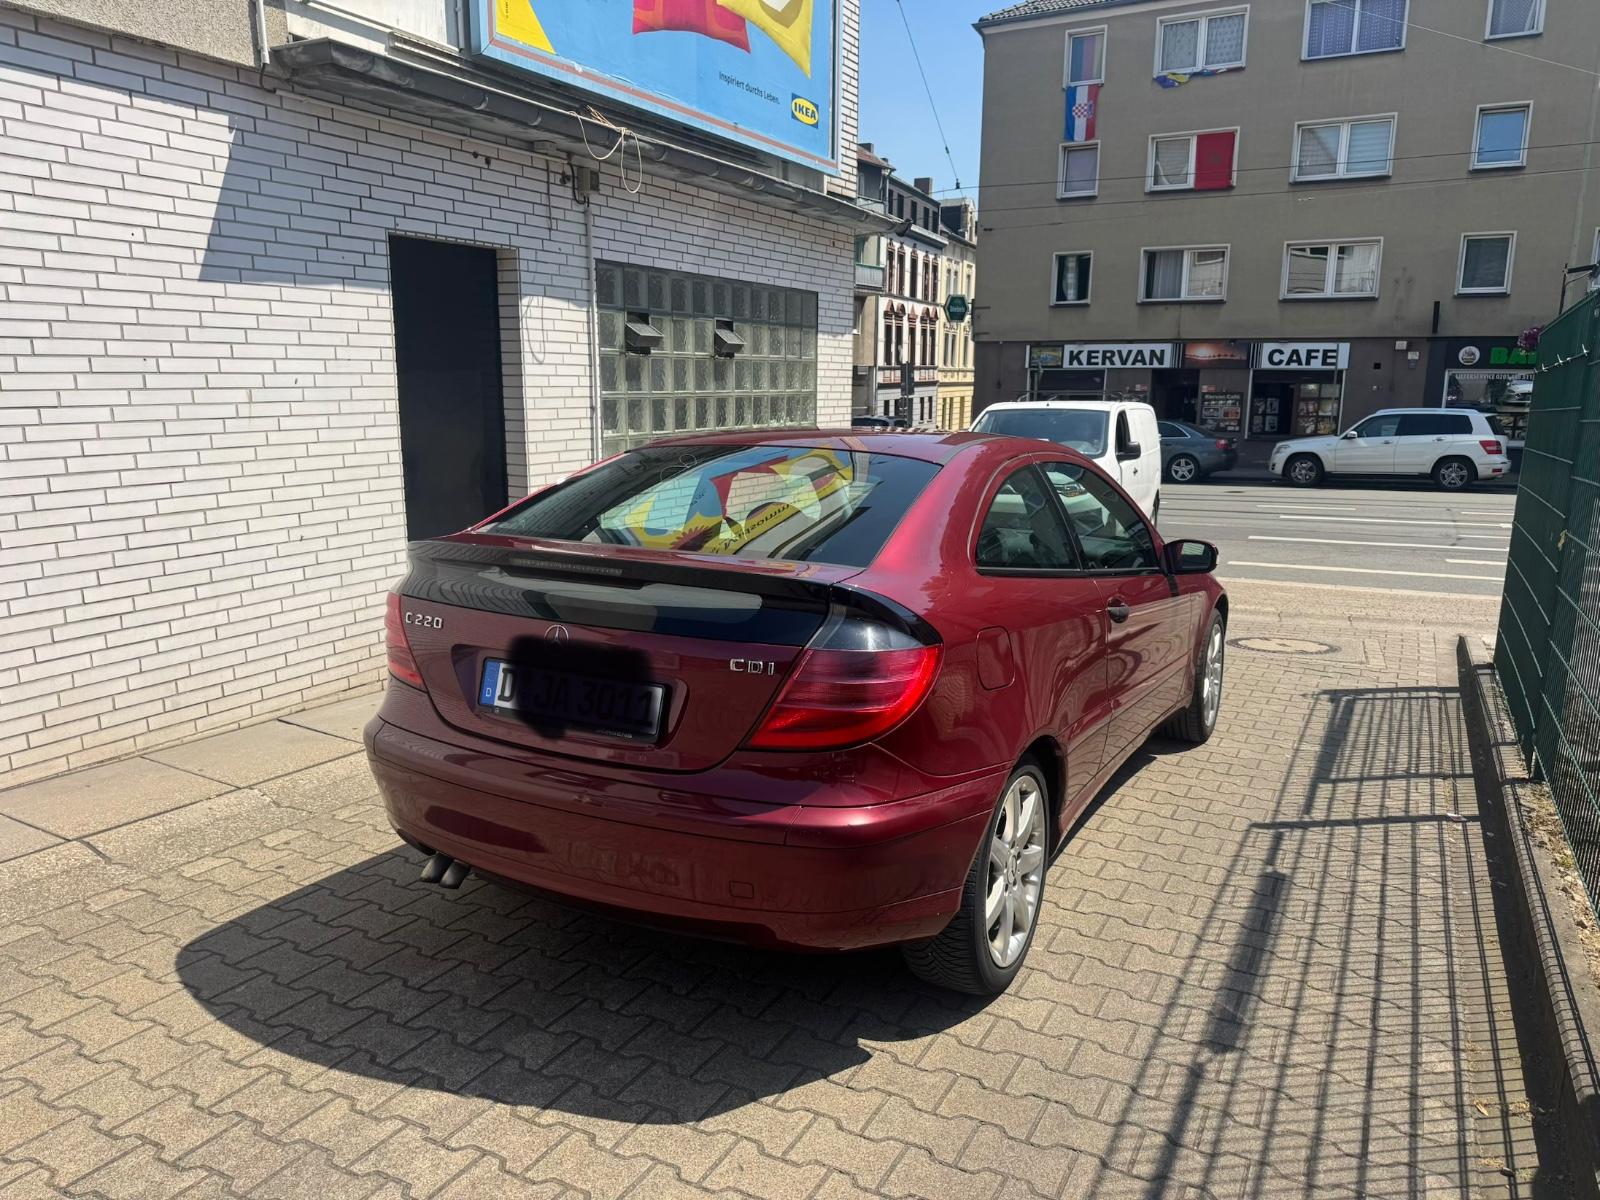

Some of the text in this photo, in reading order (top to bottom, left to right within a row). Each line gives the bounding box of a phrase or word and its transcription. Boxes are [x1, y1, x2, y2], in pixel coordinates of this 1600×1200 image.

[719, 71, 780, 105] Inspiriert durchs Leben.
[794, 101, 817, 121] IKEA
[1068, 349, 1165, 366] KERVAN
[1267, 348, 1338, 366] CAFE
[729, 658, 774, 676] CDI
